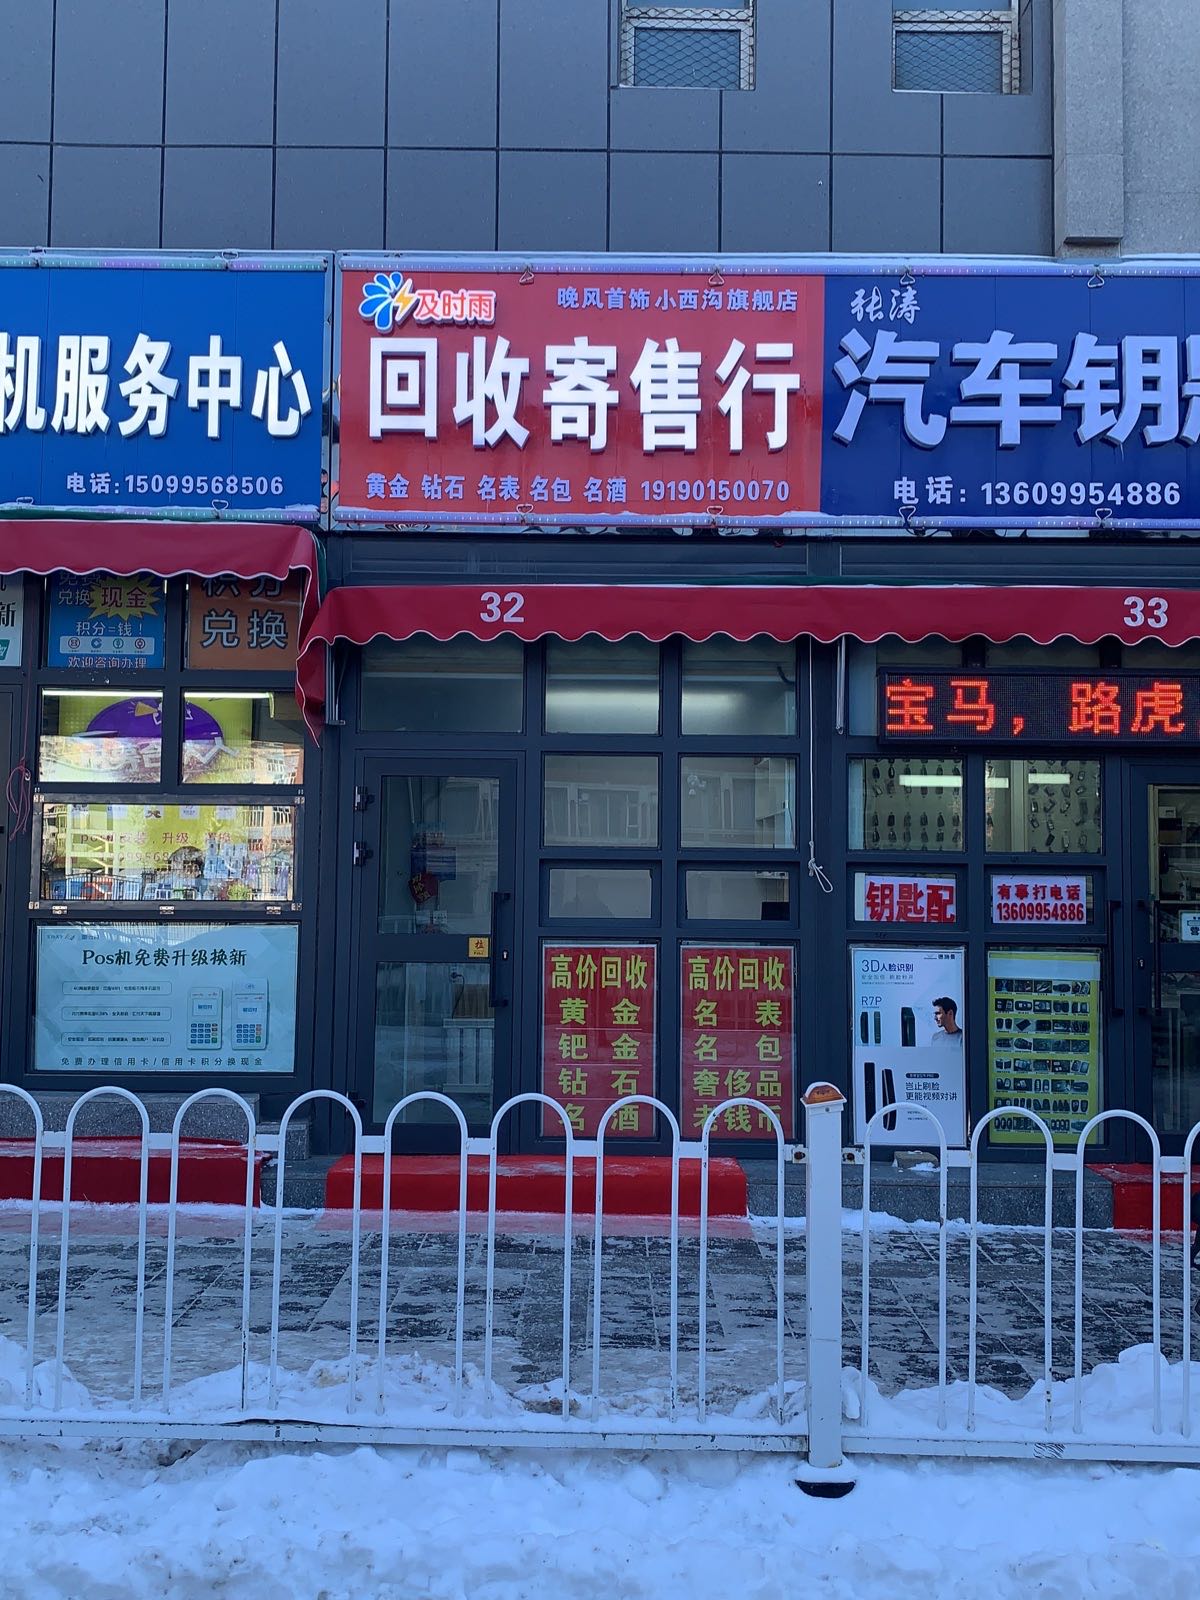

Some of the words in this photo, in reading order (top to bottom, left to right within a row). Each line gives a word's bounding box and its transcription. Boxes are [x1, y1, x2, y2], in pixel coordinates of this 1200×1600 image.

[413, 289, 497, 323] 及时雨
[556, 286, 798, 312] 晚风首饰小西沟旗舰店
[0, 331, 312, 439] 机服务中心
[368, 335, 801, 454] 回收寄售行
[832, 328, 1200, 449] 汽车钥
[66, 472, 284, 496] 电话:15099568506
[365, 472, 410, 500] 黄金
[421, 474, 465, 500] 钻石
[477, 474, 521, 501] 名表
[529, 476, 572, 502] 名包
[583, 477, 628, 502] 名酒
[640, 479, 790, 502] 19190150070
[101, 586, 148, 609] 现金
[480, 591, 525, 623] 32
[1122, 595, 1169, 628] 33
[201, 609, 288, 650] 兑换
[67, 656, 147, 669] 欢迎咨询办理
[865, 882, 956, 922] 钥匙配
[996, 884, 1081, 900] 有事打电话
[996, 902, 1085, 921] 13609954886
[81, 948, 248, 967] Pos机免费升级换新
[861, 959, 914, 973] 3D人脸识别
[551, 954, 648, 990] 高价回收
[688, 956, 785, 991] 高价回收
[559, 998, 641, 1025] 黄金
[693, 999, 783, 1027] 名表
[558, 1033, 641, 1060] 钯金
[693, 1033, 783, 1061] 名包
[558, 1067, 641, 1095] 钻石
[693, 1068, 782, 1097] 奢侈品
